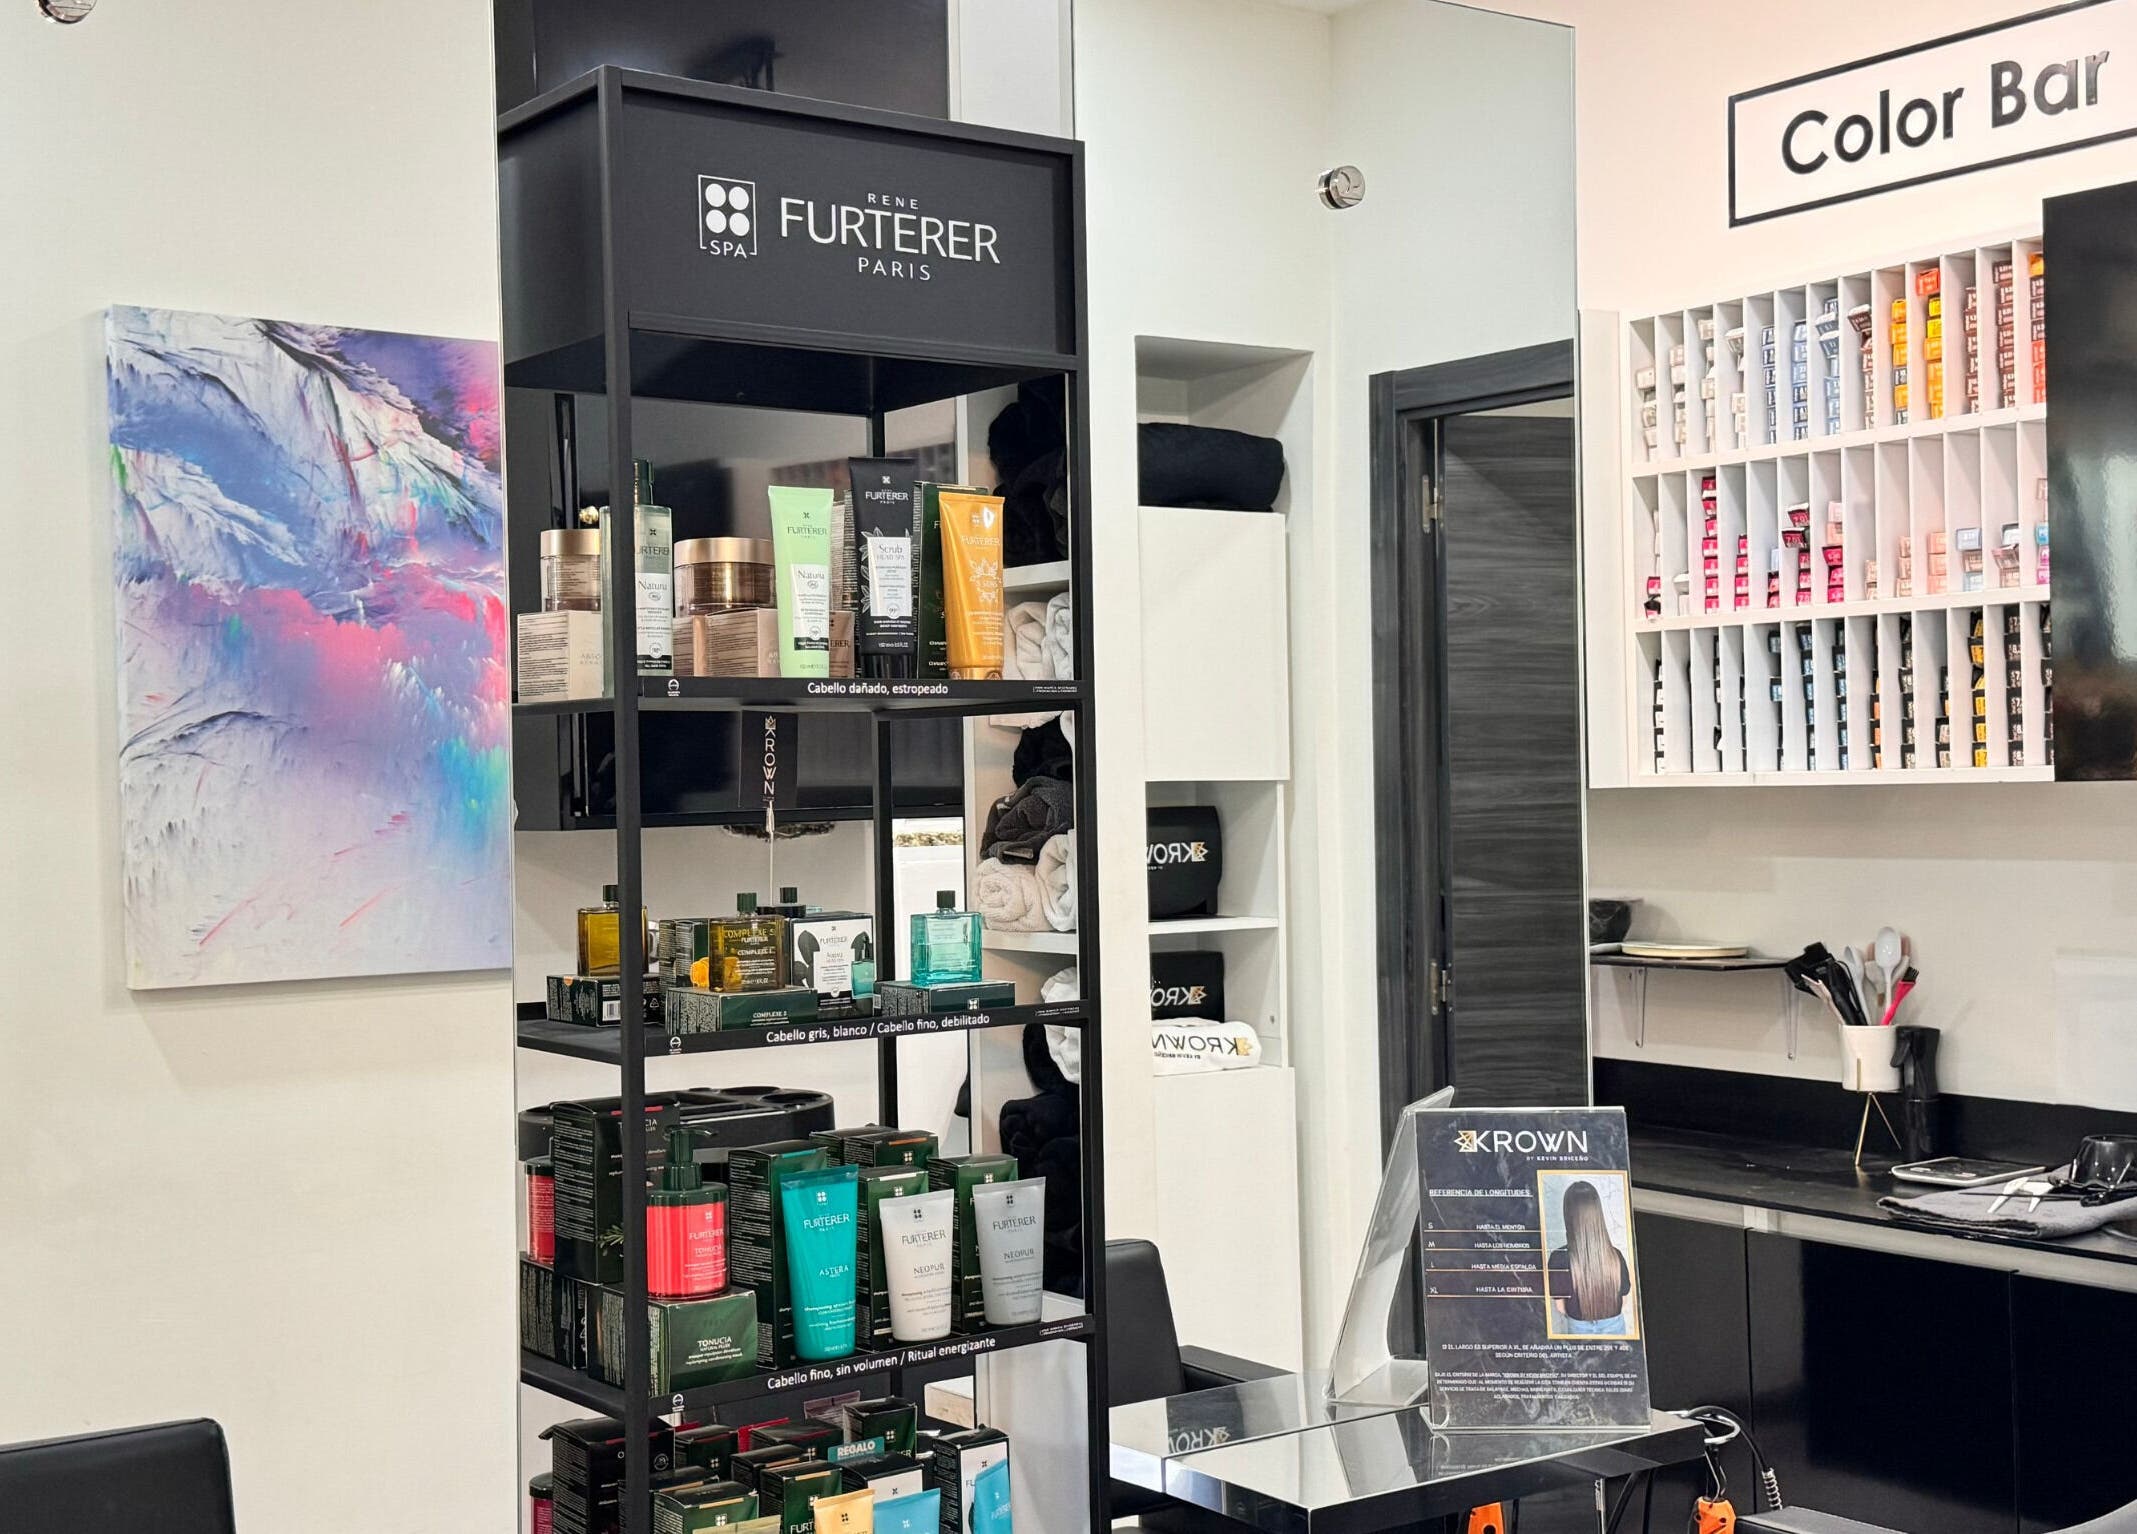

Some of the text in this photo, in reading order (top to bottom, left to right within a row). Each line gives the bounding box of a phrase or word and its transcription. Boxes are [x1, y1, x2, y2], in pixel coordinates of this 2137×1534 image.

[1781, 50, 2110, 175] Color Bar
[867, 193, 919, 210] RENE
[780, 197, 1001, 264] FURTERER
[709, 239, 748, 260] SPA
[858, 256, 931, 281] PARIS
[865, 490, 909, 501] FURTERER
[787, 526, 828, 536] FURTERER
[807, 682, 949, 698] Cabello dañado, estropeado
[763, 729, 776, 795] KROWN
[766, 1014, 990, 1043] Cabello gris, blanco / Cabello fino, debilitado
[1474, 1130, 1589, 1154] KROWN
[1484, 1188, 1531, 1196] LONGITUDES
[804, 1214, 850, 1230] FURTERER
[992, 1215, 1037, 1232] FURTERER
[902, 1230, 946, 1245] FURTERER
[819, 1264, 849, 1277] ASTERA
[914, 1262, 945, 1275] NEOPUR
[698, 1336, 732, 1348] TONUCIA
[768, 1336, 996, 1390] Cabello fino, sin volumen / Ritual energizante
[837, 1440, 876, 1457] REGALO
